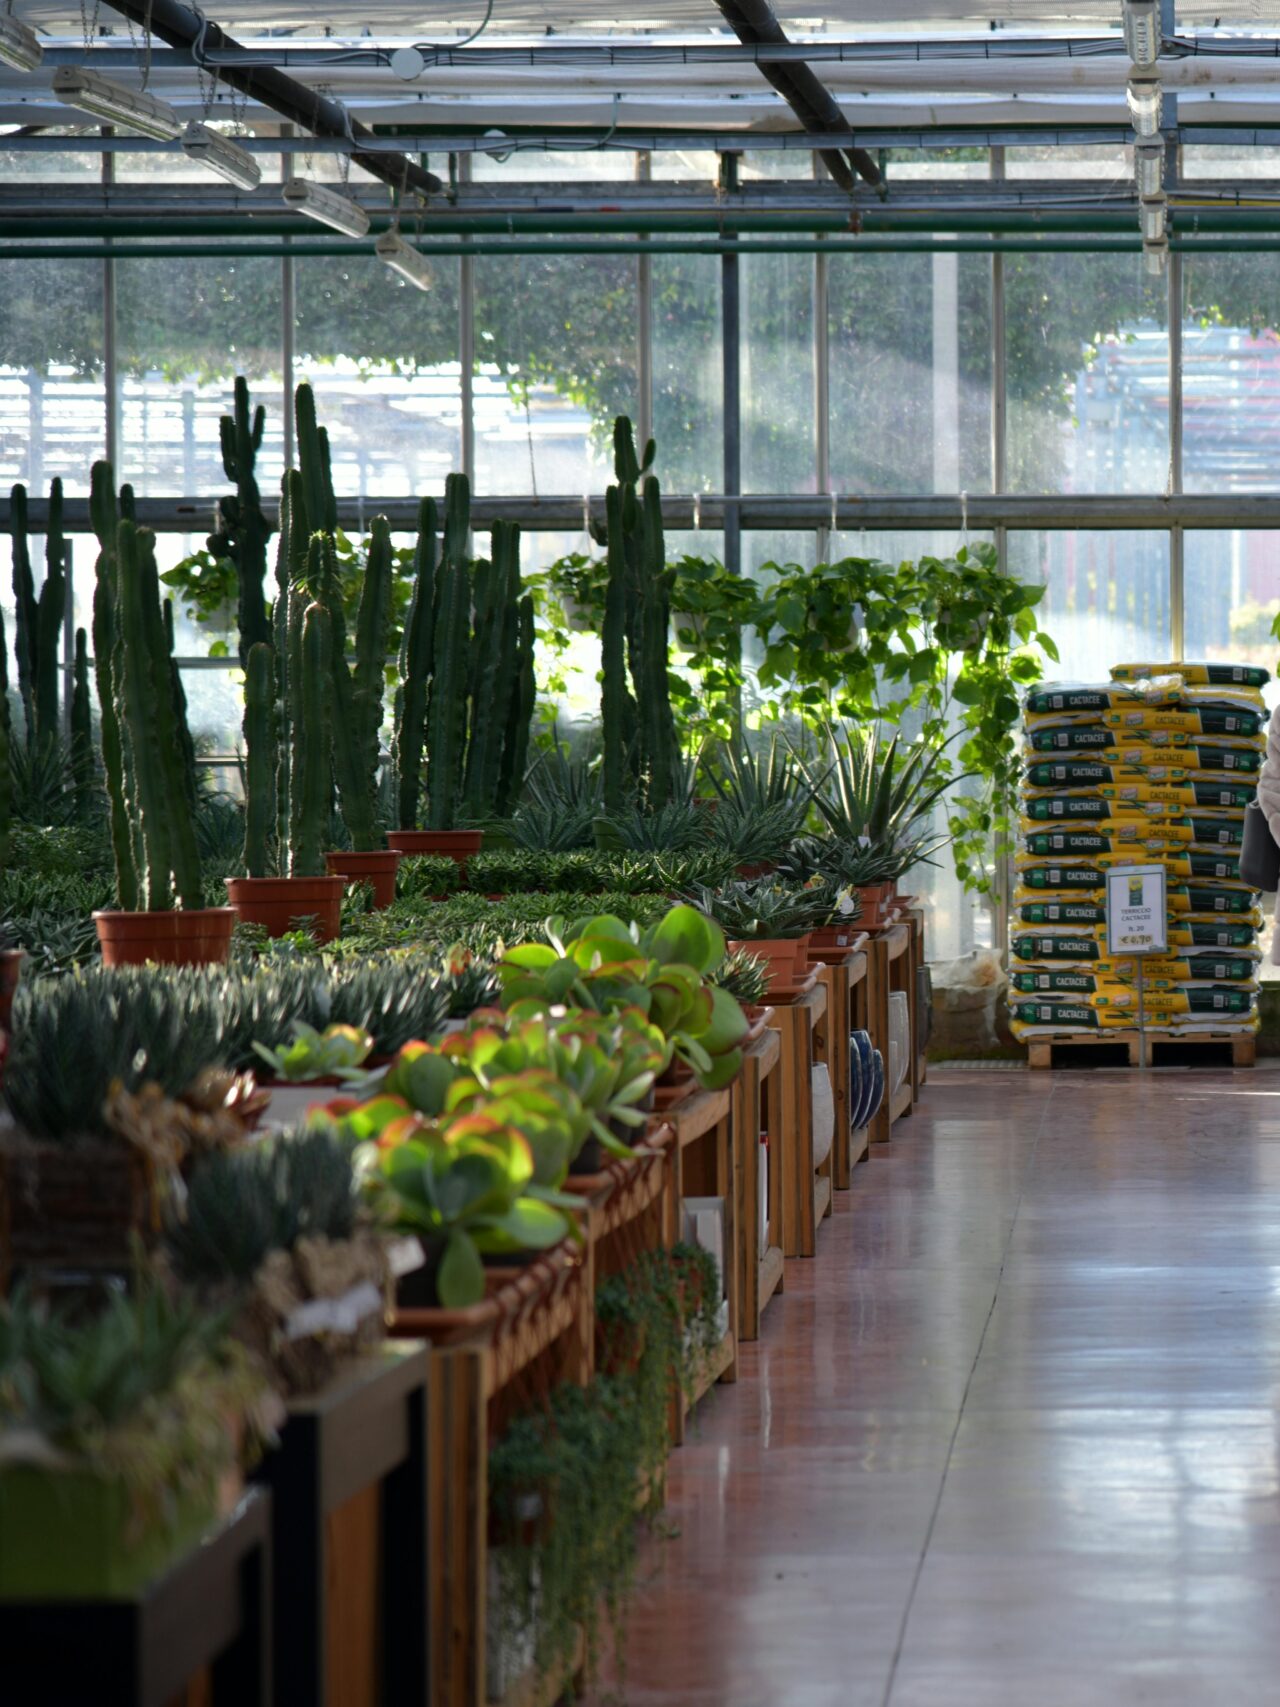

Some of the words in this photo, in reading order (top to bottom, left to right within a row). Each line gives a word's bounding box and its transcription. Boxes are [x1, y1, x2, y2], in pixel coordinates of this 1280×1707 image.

[1069, 695, 1101, 705] CACTACEE
[1074, 733, 1105, 743] CACTACEE
[1072, 767, 1104, 777] CACTACEE
[1150, 791, 1180, 800] CACTACEE
[1069, 802, 1101, 811] CACTACEE
[1070, 837, 1102, 846] CACTACEE
[1066, 871, 1098, 881] CACTACEE
[1066, 907, 1097, 917] CACTACEE
[1120, 907, 1152, 915] TERRICCIO
[1121, 914, 1151, 922] CACTACEE
[1058, 941, 1090, 951] CACTACEE
[1055, 977, 1088, 986] CACTACEE
[1057, 1009, 1089, 1019] CACTACEE
